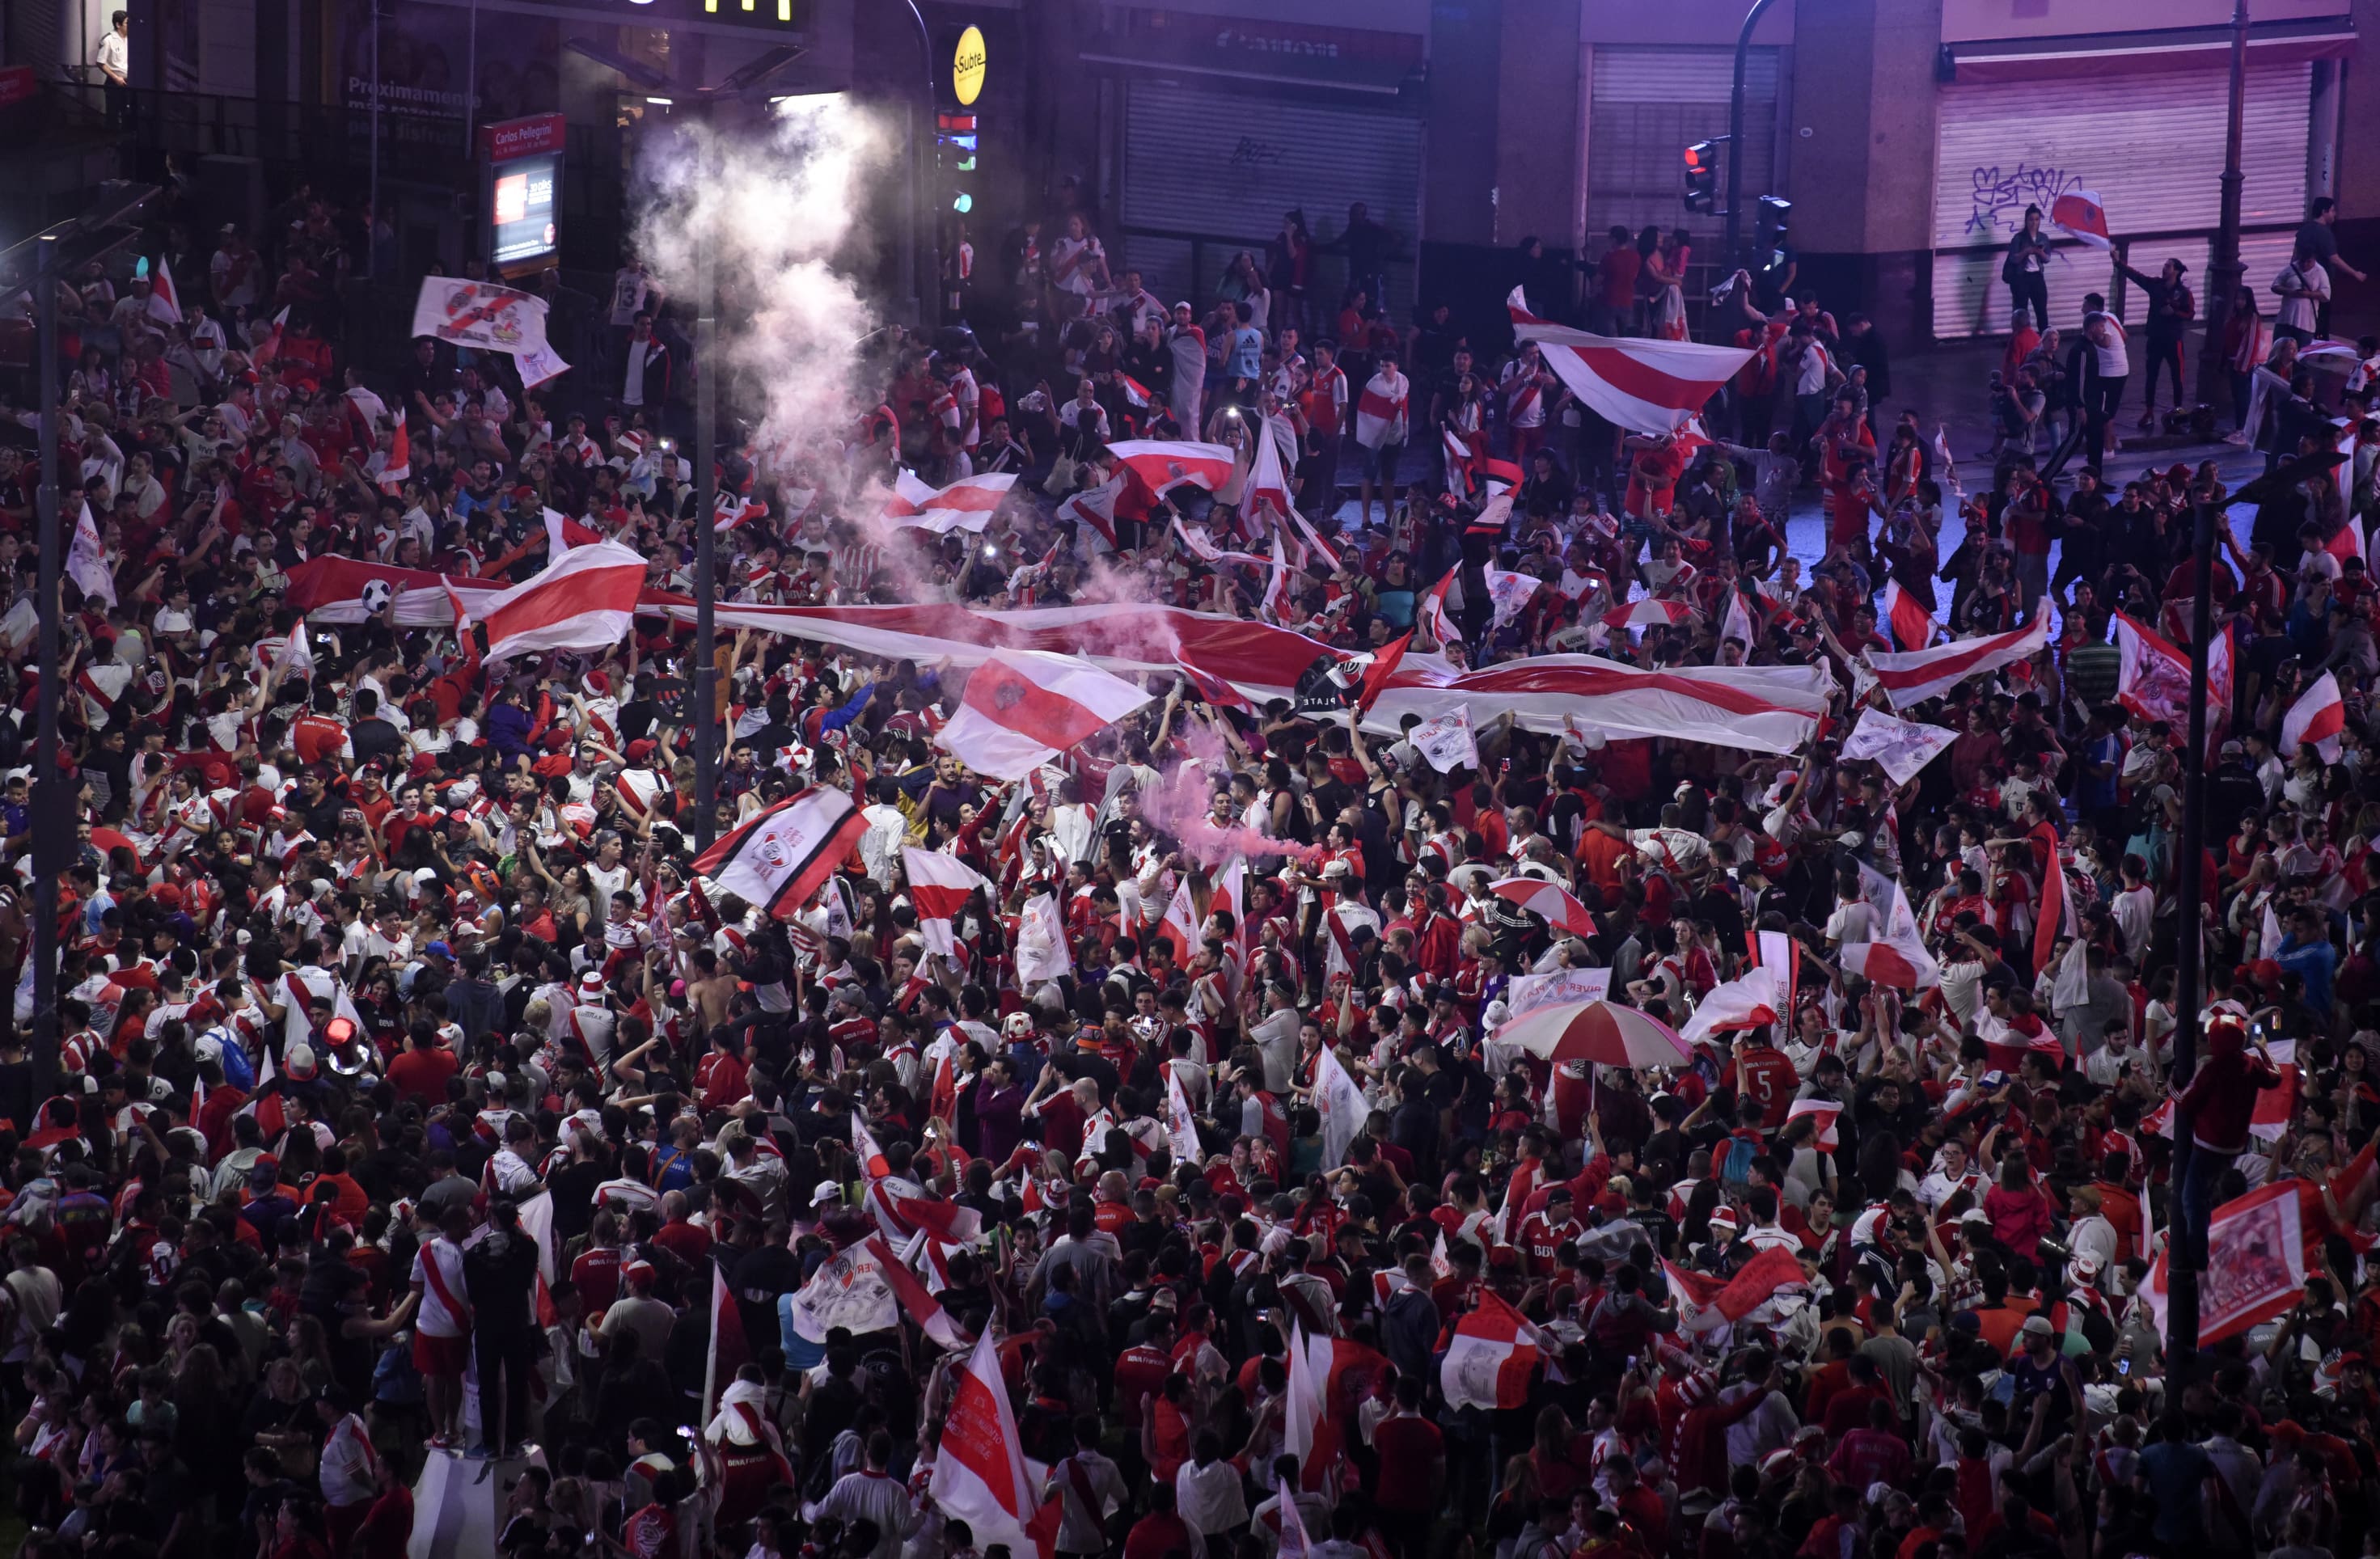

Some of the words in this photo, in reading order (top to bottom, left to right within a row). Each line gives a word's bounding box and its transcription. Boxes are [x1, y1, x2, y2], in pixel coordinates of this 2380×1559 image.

[958, 52, 982, 73] Subte
[496, 130, 518, 145] Carlos
[519, 122, 552, 141] Pellegrini
[1756, 1070, 1771, 1101] 5
[1532, 1244, 1555, 1258] BBV
